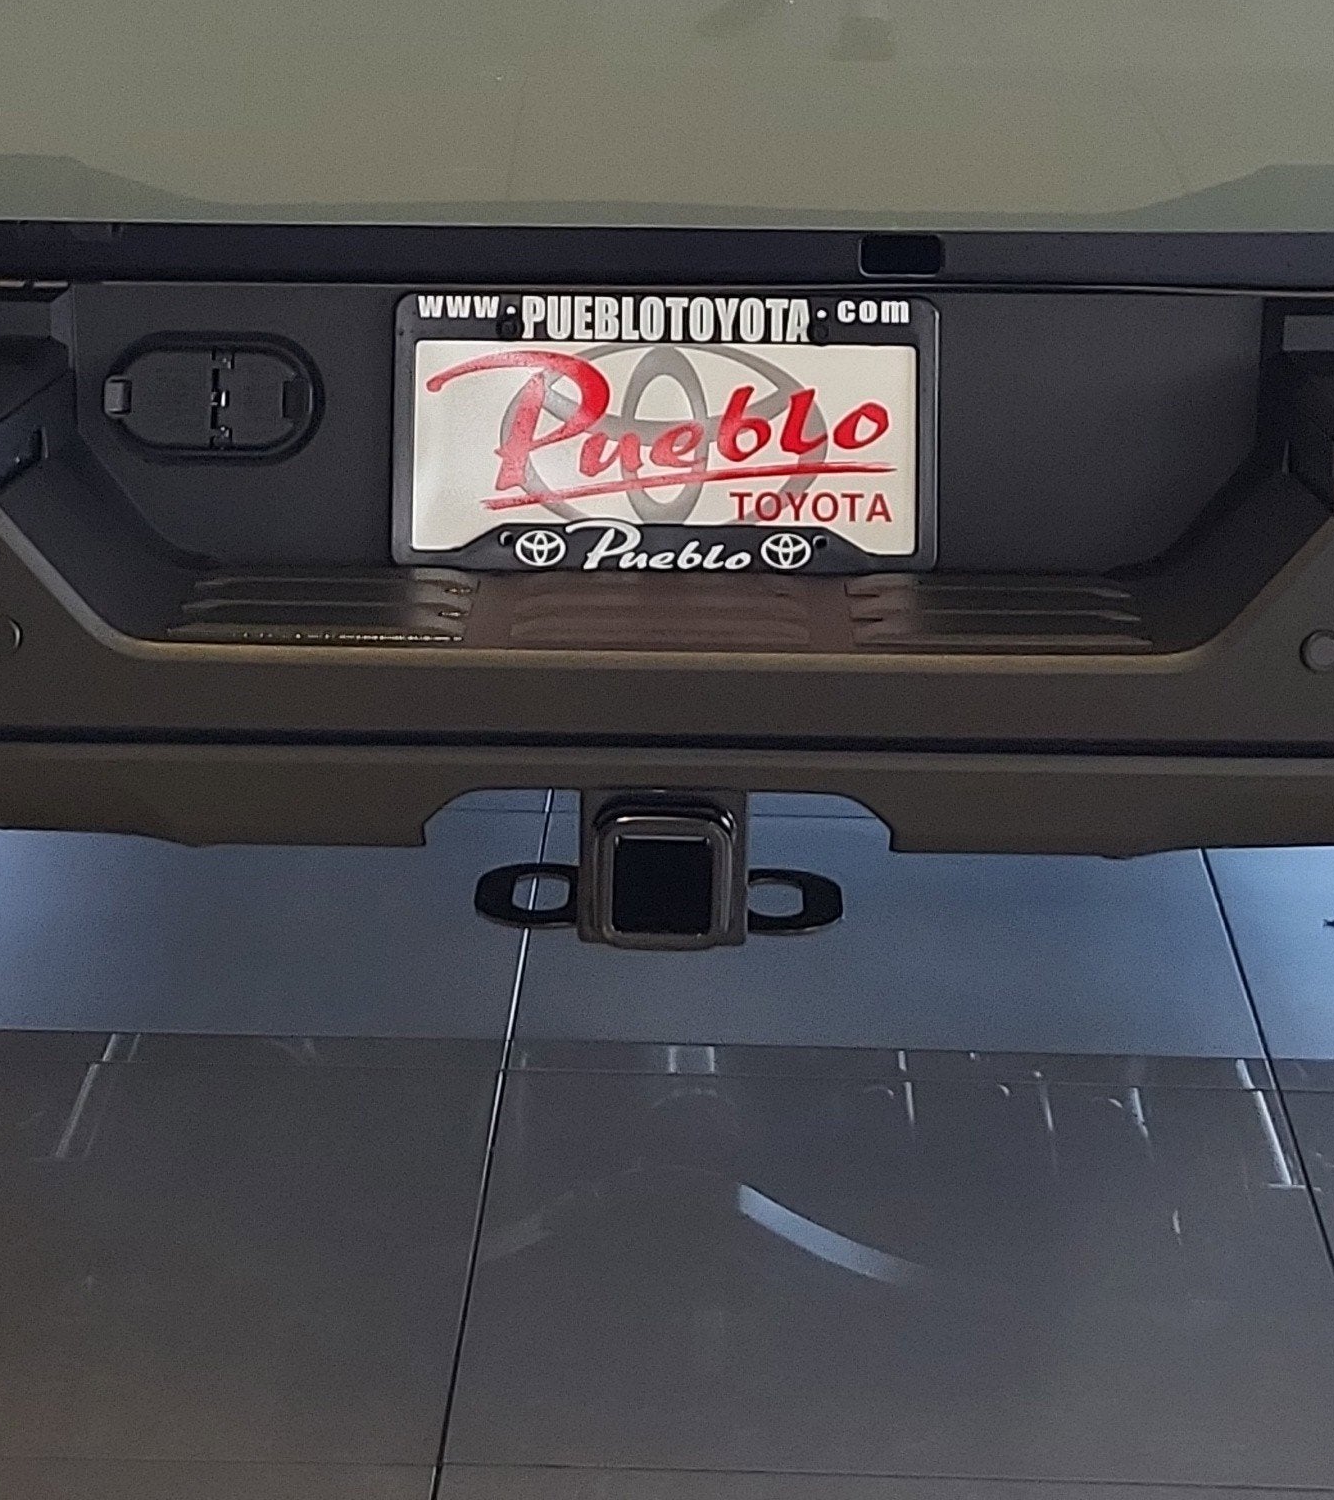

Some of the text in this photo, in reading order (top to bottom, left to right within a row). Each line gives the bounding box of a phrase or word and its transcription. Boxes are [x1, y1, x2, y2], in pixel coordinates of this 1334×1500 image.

[521, 295, 811, 343] PUEBLOTOYOTA
[426, 350, 889, 490] Pueblo
[730, 491, 892, 523] TOYOTA
[566, 518, 751, 570] Pueblo
